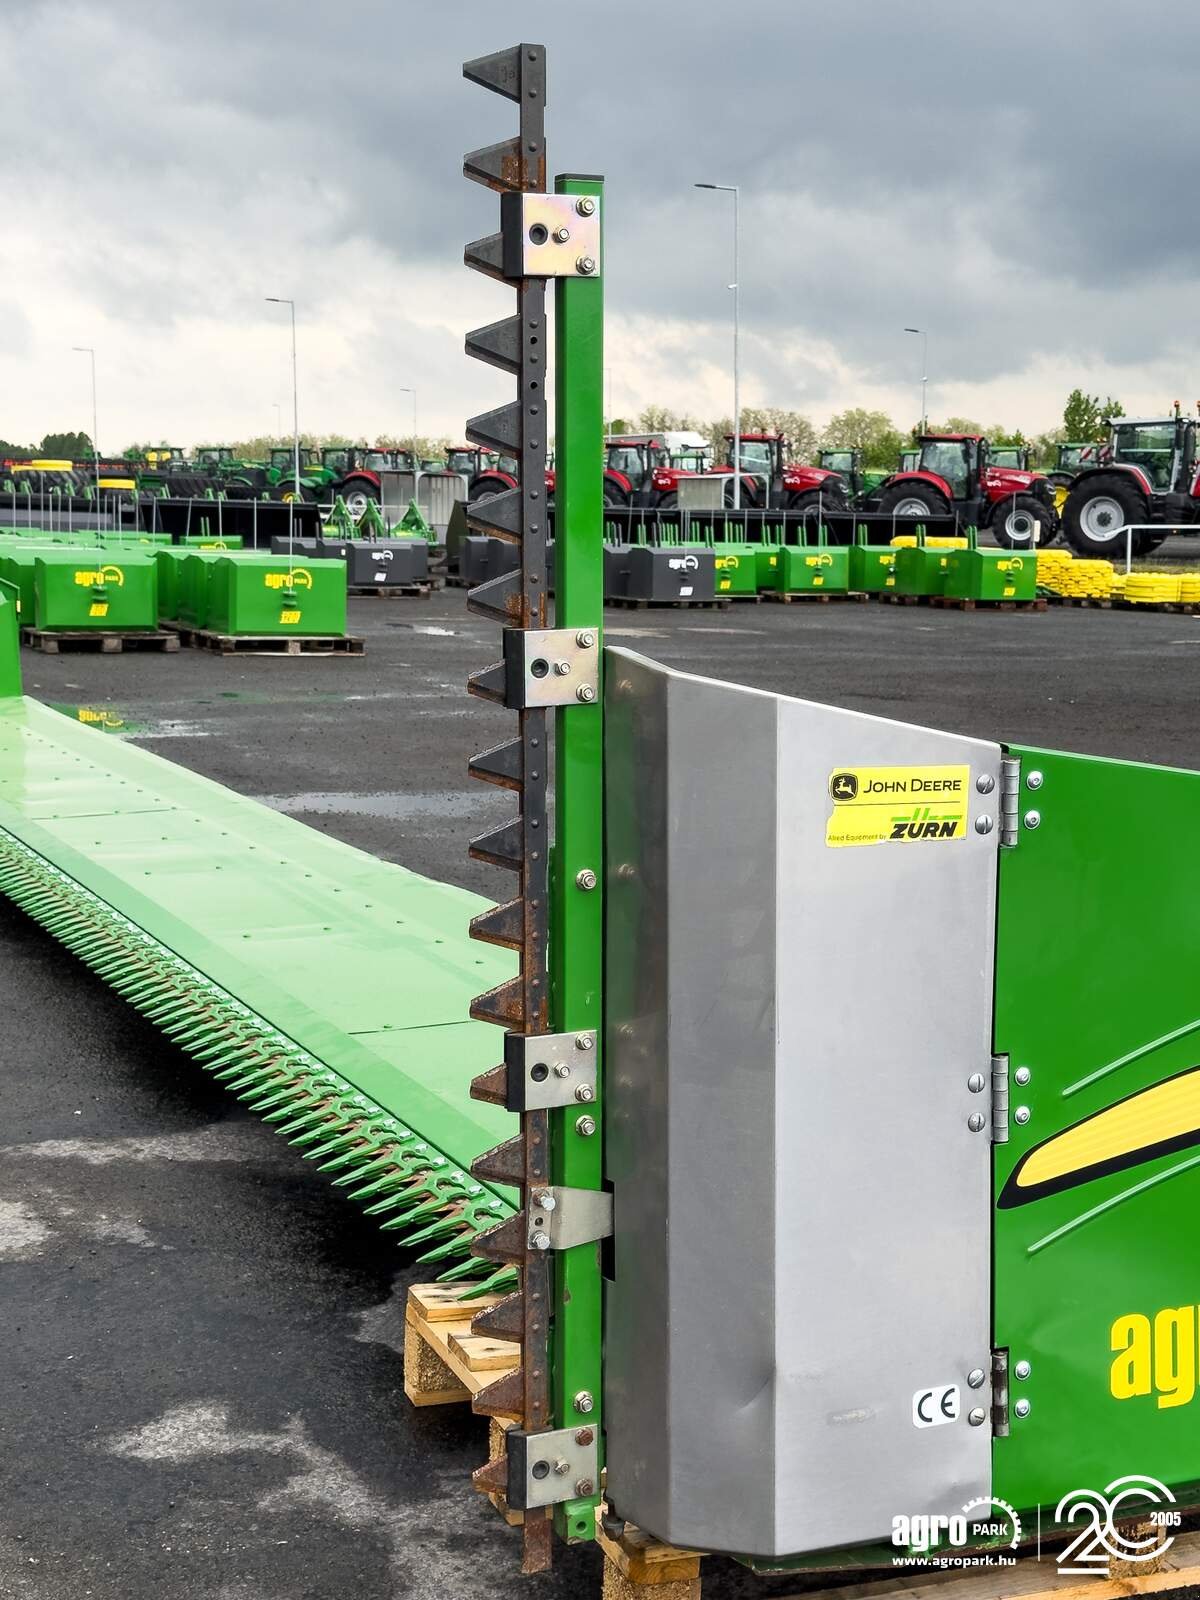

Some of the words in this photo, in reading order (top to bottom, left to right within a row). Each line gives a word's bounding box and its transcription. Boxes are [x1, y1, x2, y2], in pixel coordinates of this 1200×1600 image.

[75, 571, 104, 587] agro
[265, 573, 294, 589] agro
[863, 779, 907, 794] JOHN
[911, 778, 962, 792] DEERE
[1110, 1304, 1200, 1409] ag
